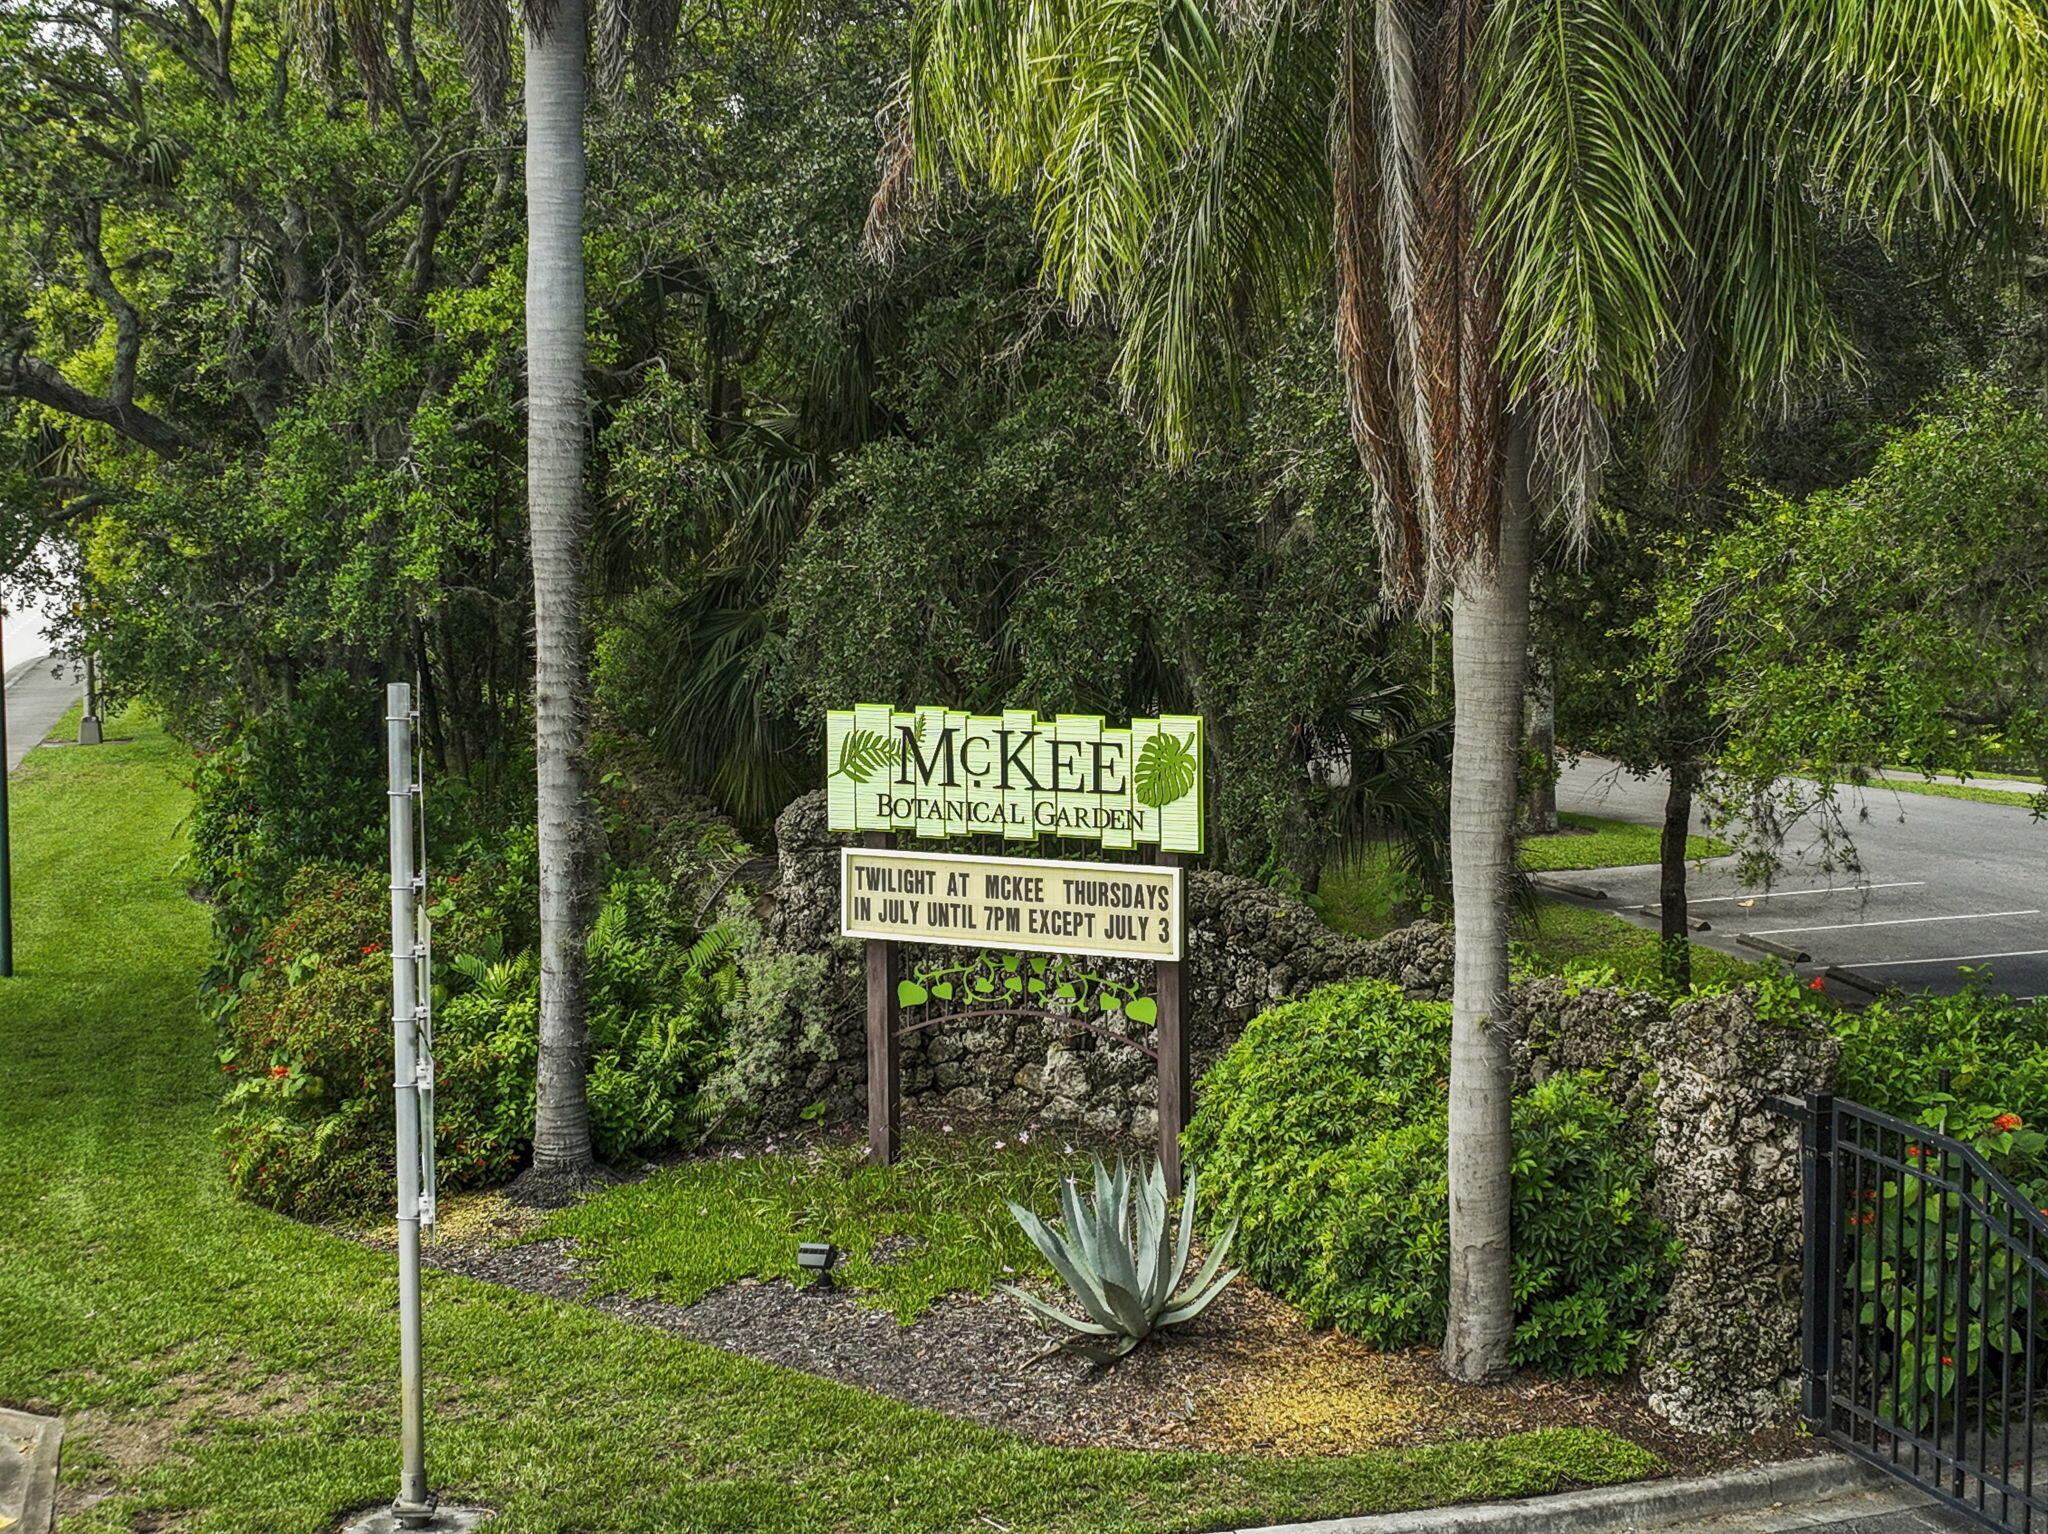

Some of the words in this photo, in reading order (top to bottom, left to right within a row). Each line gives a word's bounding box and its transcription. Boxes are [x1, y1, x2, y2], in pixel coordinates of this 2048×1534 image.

[854, 866, 936, 896] TWILIGHT
[947, 872, 969, 897] AT
[986, 874, 1044, 903] MCKEE
[1063, 879, 1169, 911] THURSDAYS
[854, 897, 871, 920] IN
[878, 900, 919, 925] JULY
[927, 903, 977, 929] UNTIL
[983, 906, 1020, 933] 7PM
[1028, 909, 1096, 938] EXCEPT
[1104, 914, 1149, 941] JULY
[1158, 918, 1170, 943] 3
